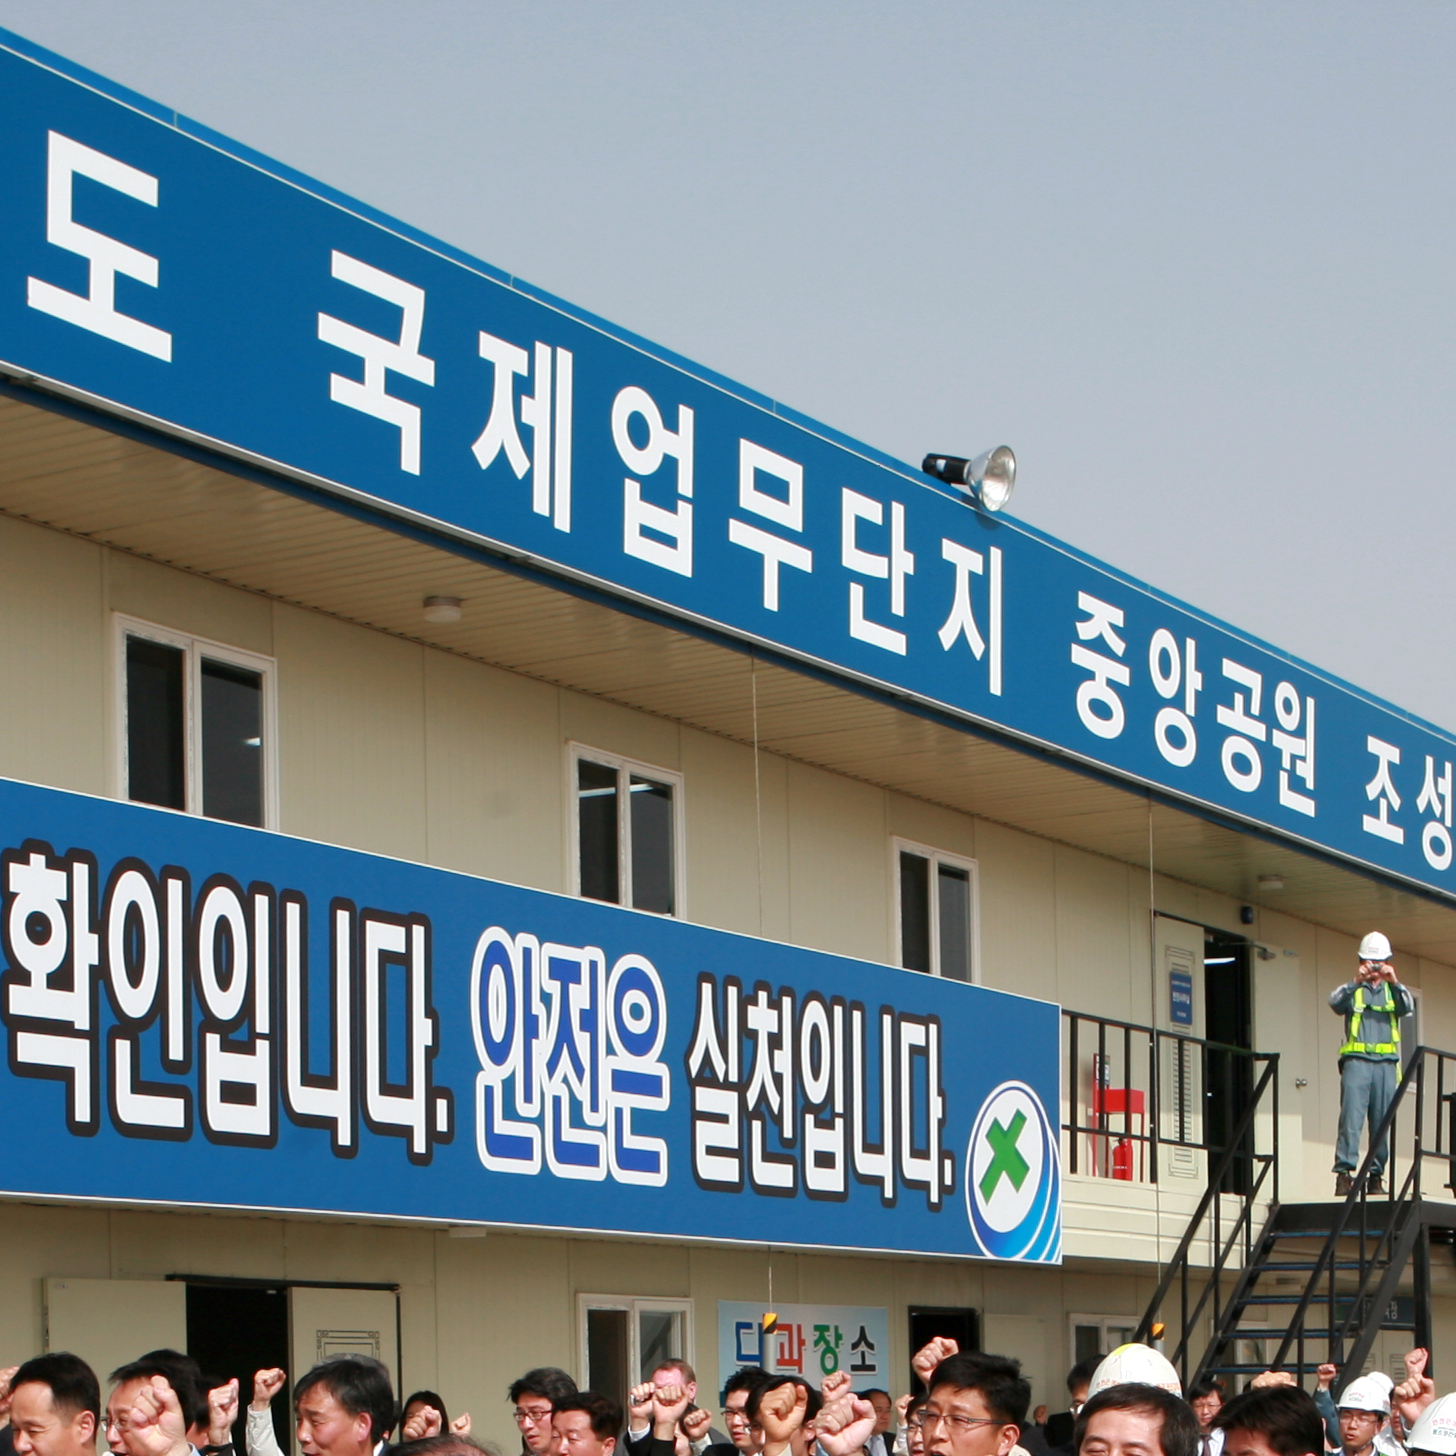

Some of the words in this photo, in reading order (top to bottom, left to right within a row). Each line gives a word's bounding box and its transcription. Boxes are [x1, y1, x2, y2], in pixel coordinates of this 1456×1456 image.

[317, 248, 1003, 698] 국제업무단지
[1070, 589, 1317, 819] 중앙공원
[3, 844, 452, 1161] 확인입니다.
[469, 924, 671, 1188] 안전은
[686, 976, 955, 1209] 실천입니다.
